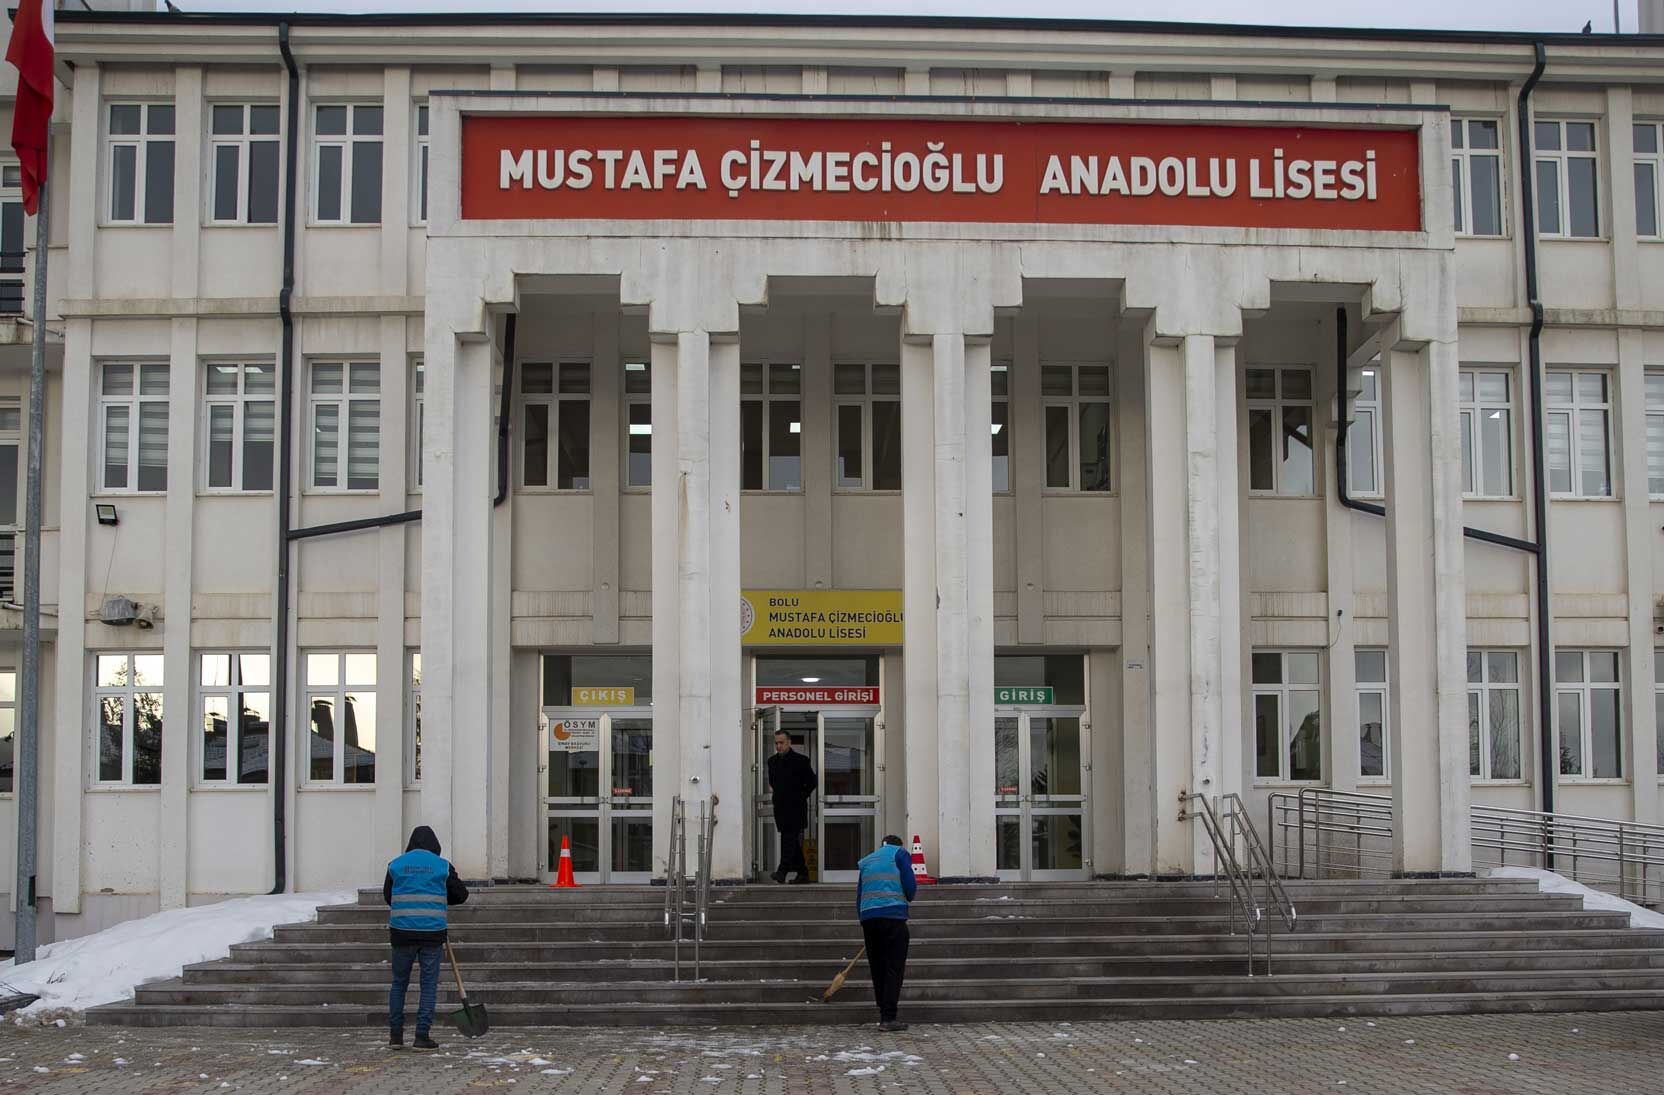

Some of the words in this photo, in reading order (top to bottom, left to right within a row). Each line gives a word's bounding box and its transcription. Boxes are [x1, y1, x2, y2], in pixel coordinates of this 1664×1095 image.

[499, 149, 708, 190] MUSTAFA
[720, 139, 1005, 198] ÇİZMECİOĞLU
[1040, 154, 1237, 198] ANADOLU
[1249, 148, 1378, 201] LİSESİ
[769, 598, 799, 607] BOLU
[769, 612, 826, 623] MUSTAFA
[768, 628, 826, 638] ANADOLU
[829, 625, 866, 638] LİSESİ
[763, 691, 832, 701] PERSONEL
[834, 689, 874, 702] GİRİŞİ
[999, 688, 1046, 703] GİRİŞ
[564, 719, 596, 729] ÖSYM
